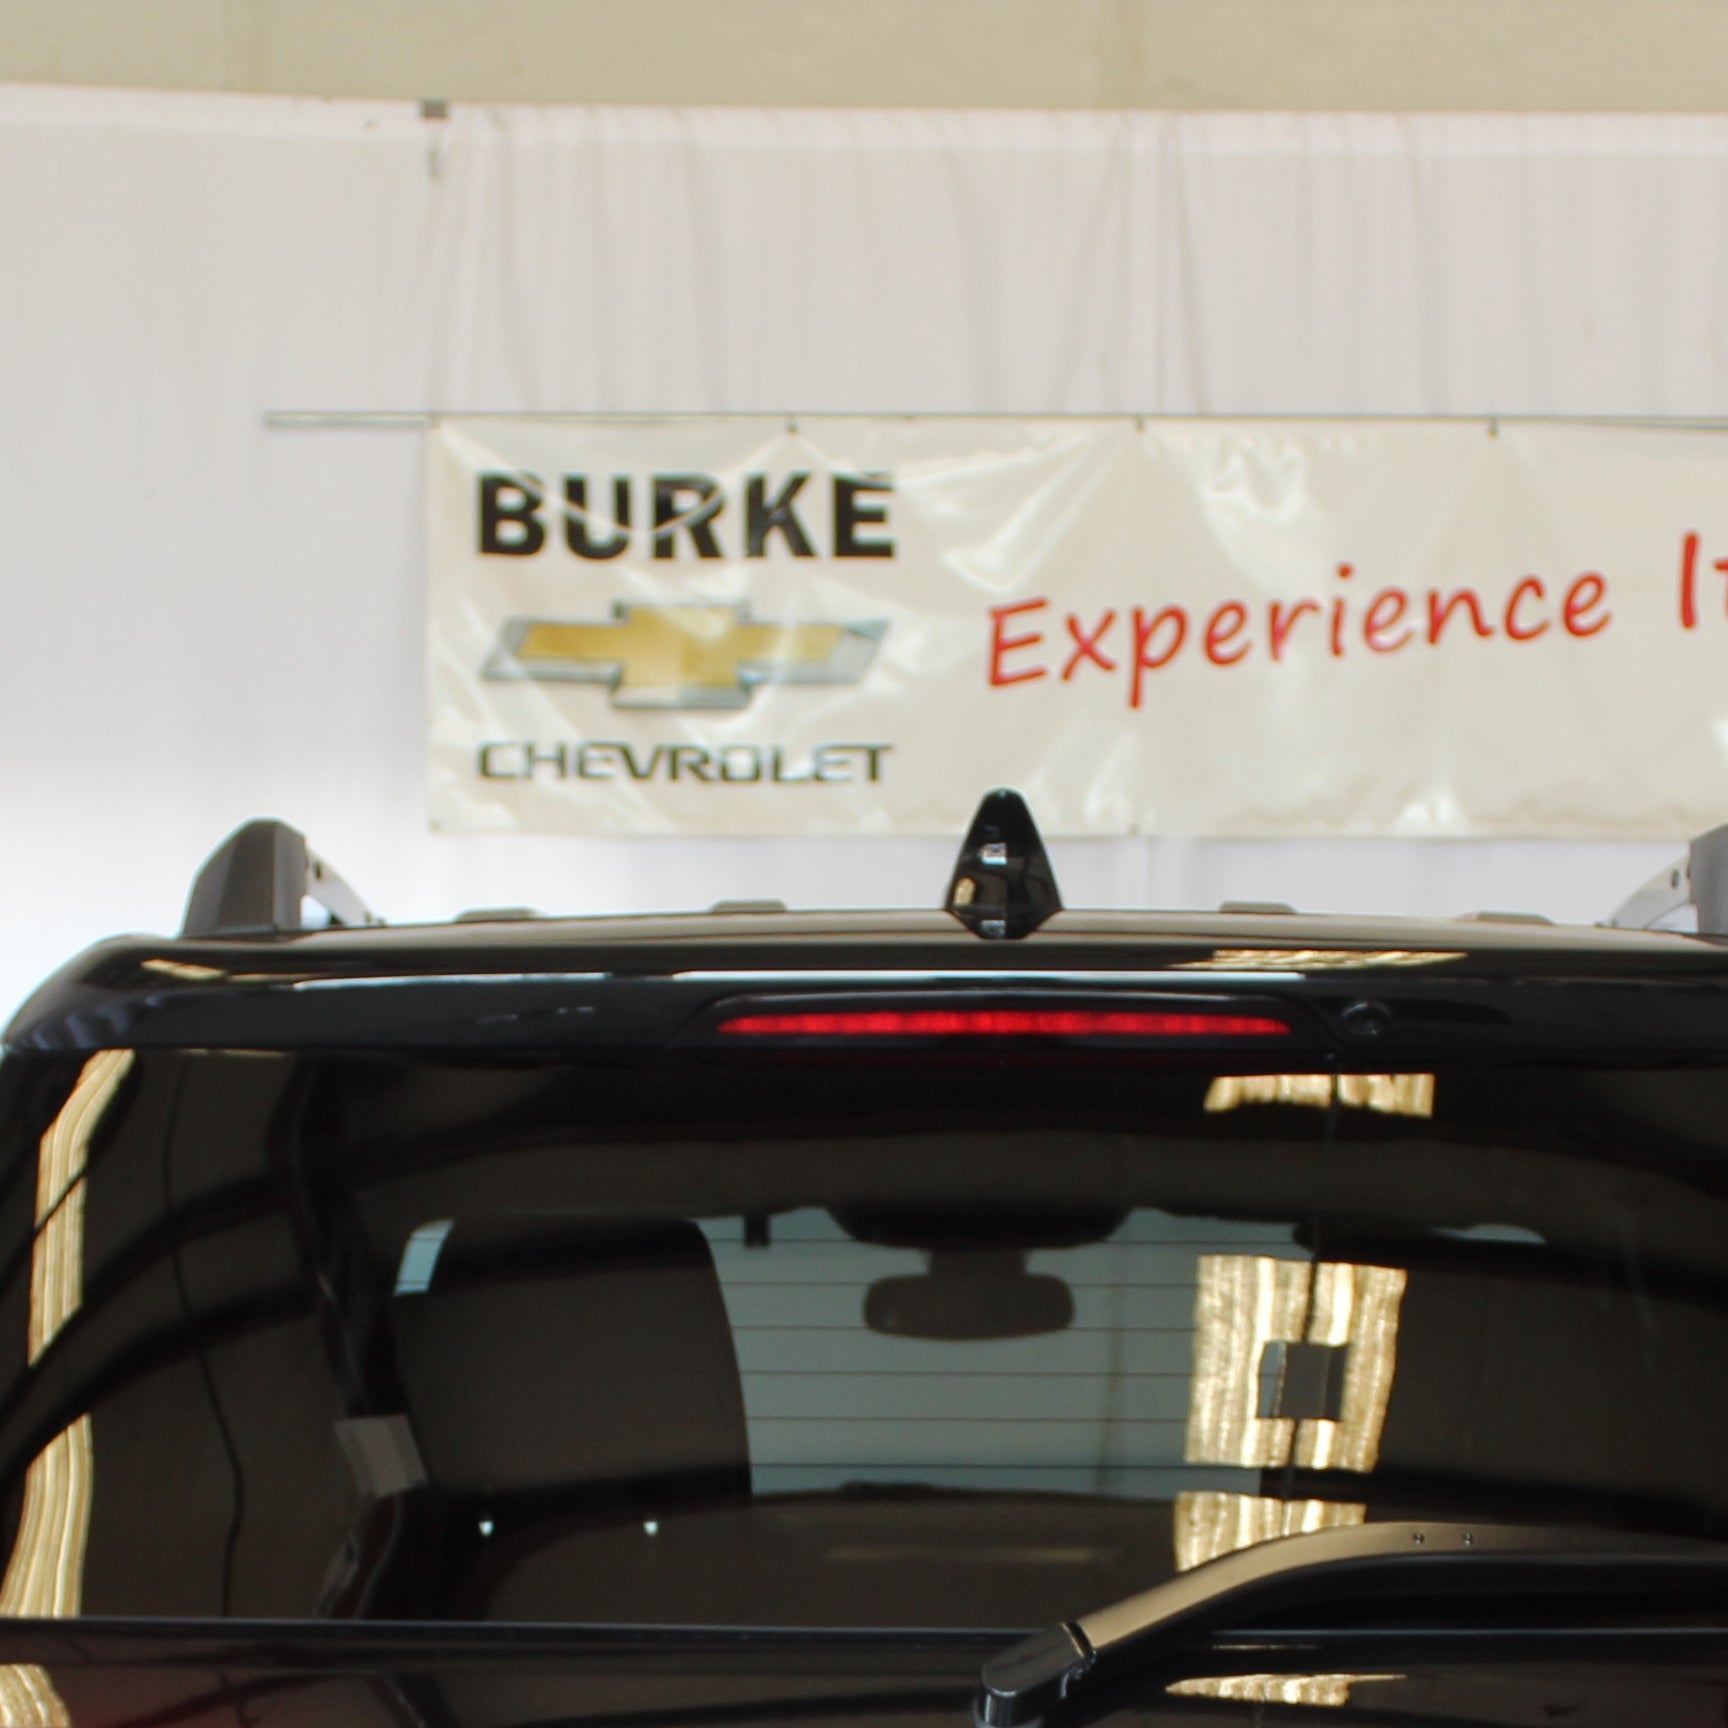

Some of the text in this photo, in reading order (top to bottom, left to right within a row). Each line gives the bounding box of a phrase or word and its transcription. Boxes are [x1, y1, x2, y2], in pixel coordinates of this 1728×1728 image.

[479, 471, 894, 560] BURKE
[988, 563, 1612, 709] Experience
[478, 741, 893, 783] CHEVROLET
